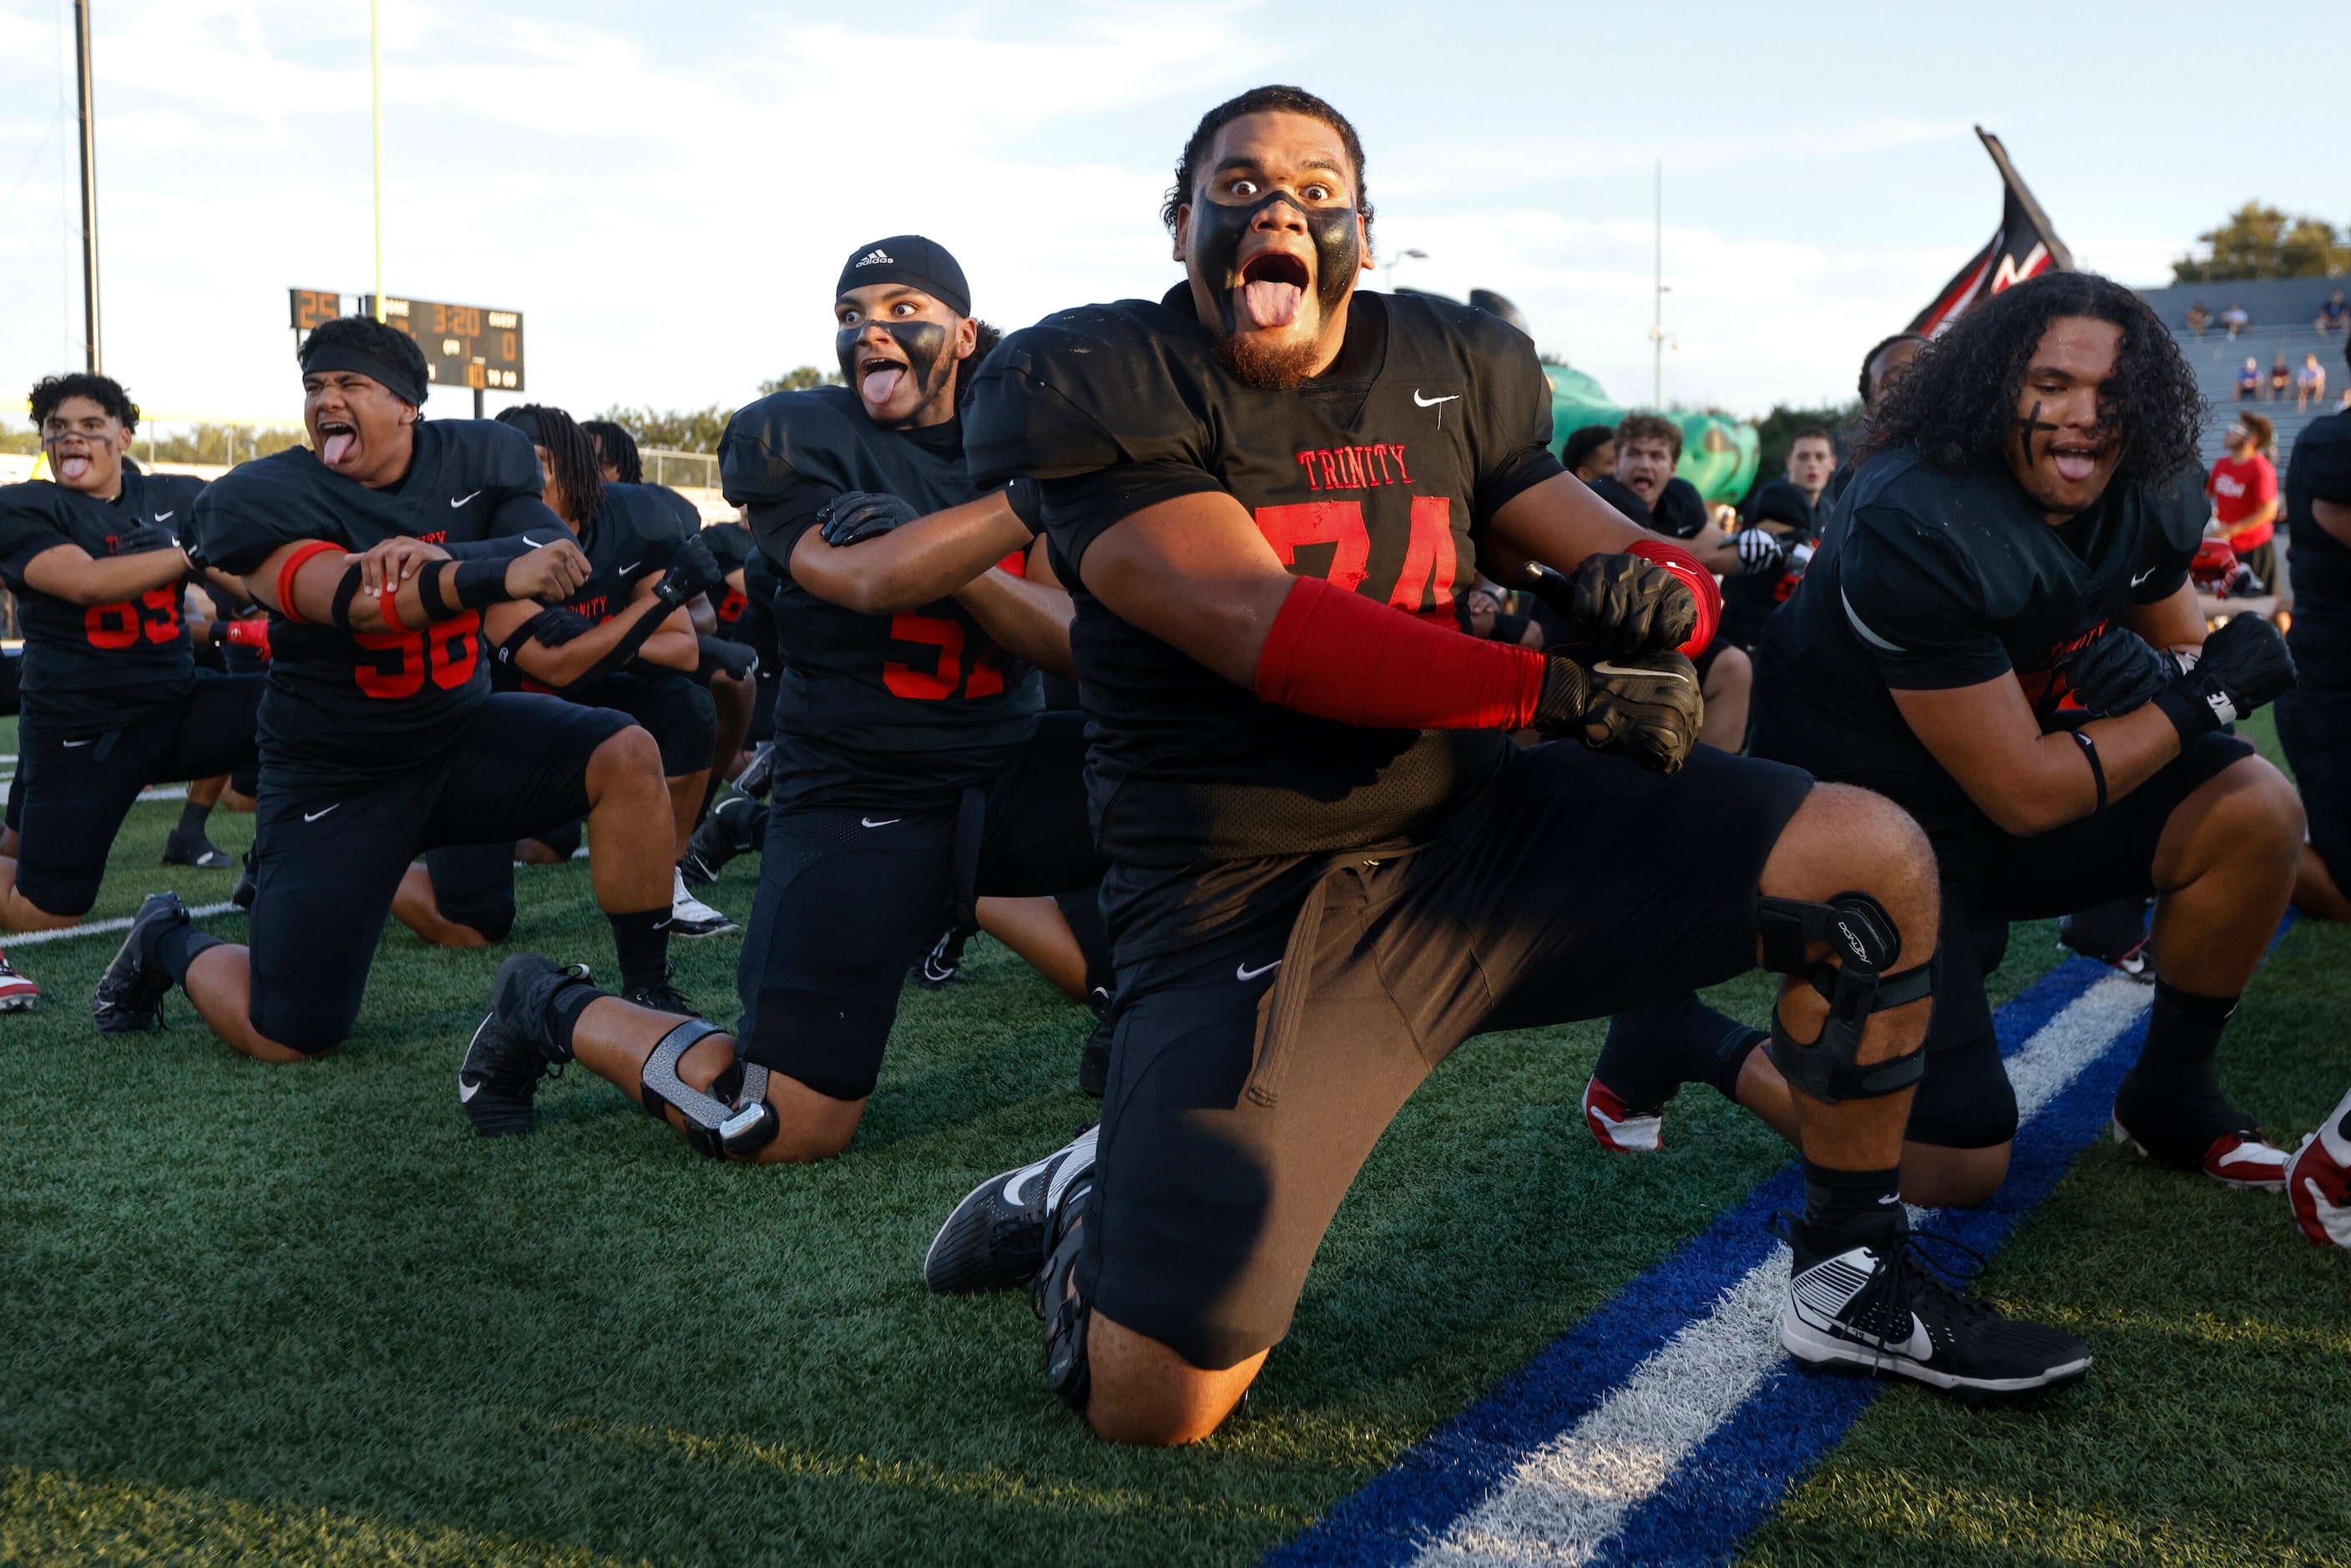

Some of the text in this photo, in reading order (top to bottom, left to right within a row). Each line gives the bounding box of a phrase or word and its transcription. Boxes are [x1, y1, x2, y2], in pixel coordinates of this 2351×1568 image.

[855, 257, 894, 268] adidas
[488, 311, 518, 329] GUEST
[1296, 443, 1416, 491] TRINITY
[1838, 921, 1873, 965] DONJOY
